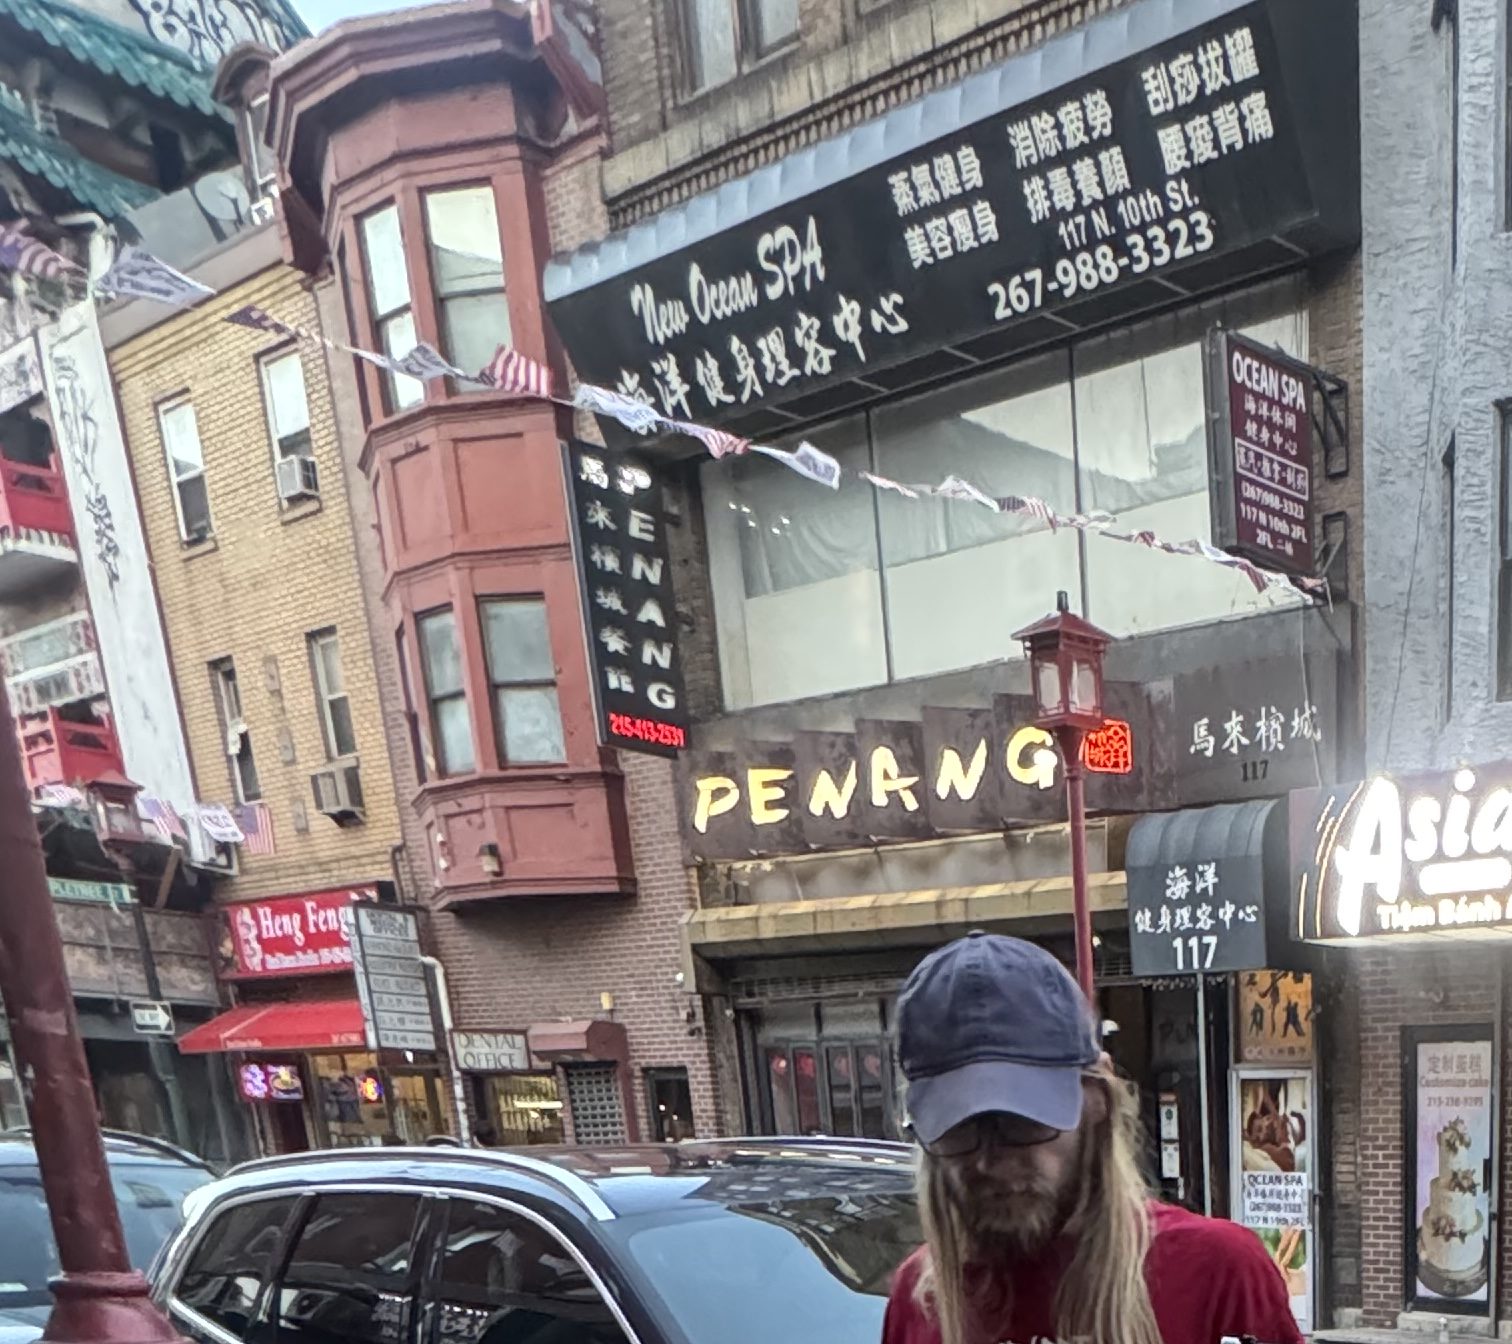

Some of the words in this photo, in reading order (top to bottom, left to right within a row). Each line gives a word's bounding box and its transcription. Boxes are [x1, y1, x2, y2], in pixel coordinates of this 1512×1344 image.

[1058, 215, 1086, 251] 117
[1091, 206, 1117, 239] N.
[1117, 188, 1164, 230] 10th
[1165, 177, 1200, 212] St.
[630, 282, 690, 346] New
[688, 260, 758, 325] Ocean
[757, 215, 825, 300] SPA
[987, 210, 1214, 320] 267-988-3323
[1232, 351, 1279, 401] OCEAN
[1281, 374, 1306, 413] SPA
[693, 725, 1057, 834] PENANG
[1240, 759, 1270, 783] 117
[257, 906, 306, 947] Heng
[305, 900, 352, 941] Feng
[1172, 934, 1218, 971] 117
[457, 1032, 522, 1050] DENTAL
[463, 1052, 517, 1069] OFFICE
